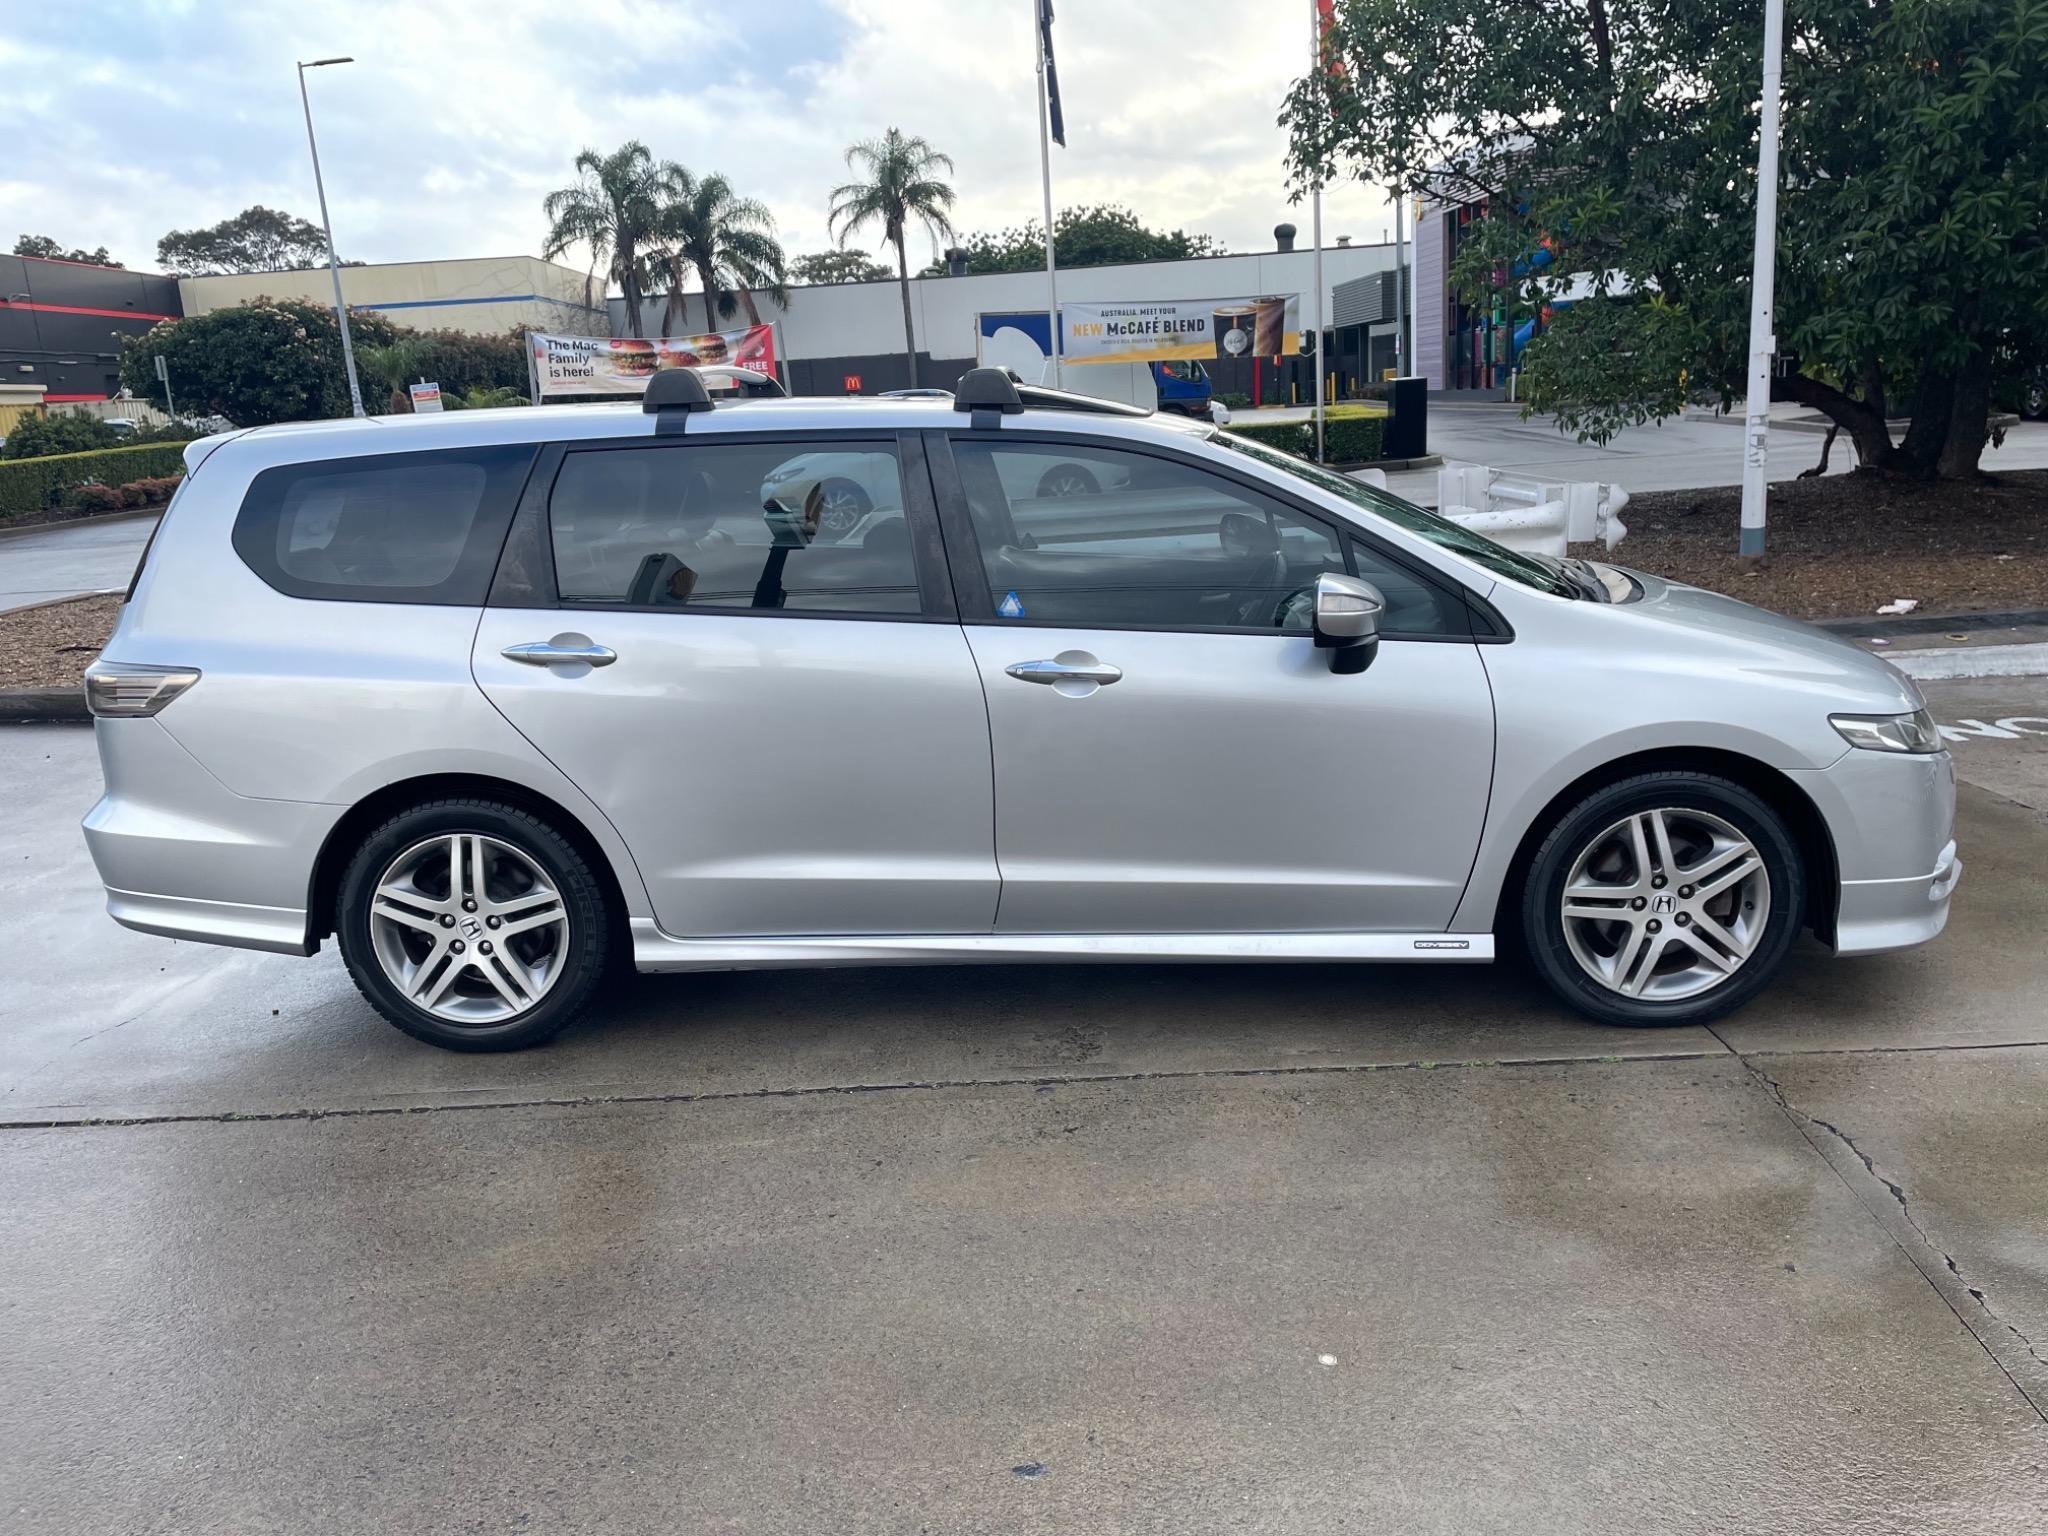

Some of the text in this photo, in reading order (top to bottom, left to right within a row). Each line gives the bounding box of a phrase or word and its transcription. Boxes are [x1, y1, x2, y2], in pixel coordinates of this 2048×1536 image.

[1140, 308, 1158, 316] MEET
[1159, 307, 1176, 315] YOUR
[1072, 323, 1103, 336] NEW
[1163, 318, 1205, 333] BLEND
[546, 340, 570, 350] The
[572, 341, 598, 351] Mac
[548, 352, 590, 366] Family
[742, 361, 768, 371] FREE
[549, 366, 594, 378] is here!
